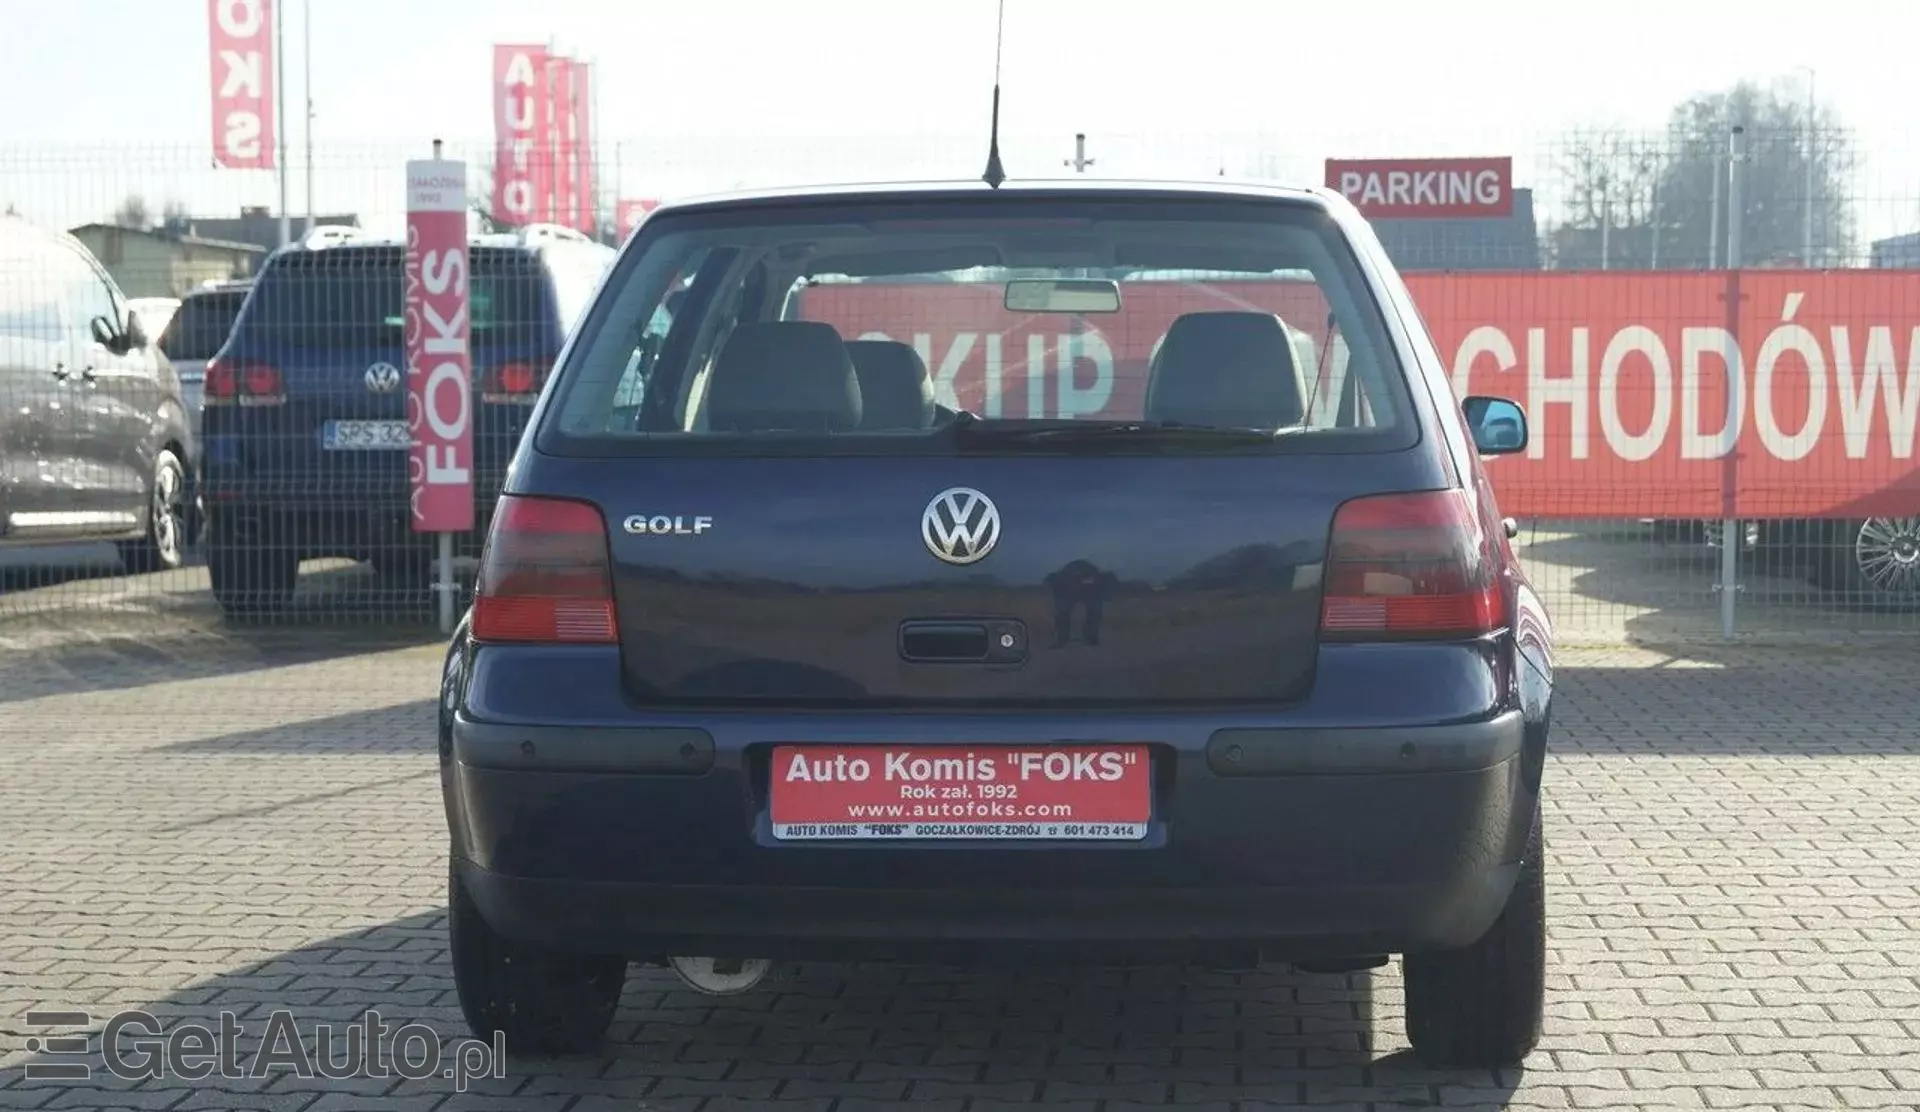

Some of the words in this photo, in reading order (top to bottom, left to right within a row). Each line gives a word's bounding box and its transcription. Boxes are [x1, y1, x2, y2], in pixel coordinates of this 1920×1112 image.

[503, 53, 535, 215] AUTO
[1340, 169, 1501, 206] PARKING
[421, 248, 469, 484] FOKS
[857, 331, 1114, 420] KUP
[623, 515, 713, 534] GOLF
[786, 753, 870, 782] Auto
[885, 752, 997, 782] Komis
[1008, 752, 1137, 781] "FOKS"
[900, 785, 936, 799] Rok
[941, 784, 973, 799] zał.
[978, 784, 1018, 799] 1992
[848, 801, 1072, 817] www.autofoks.com
[786, 825, 816, 836] AUTO
[820, 825, 858, 836] KOMIS
[915, 822, 1041, 836] GOCZAŁKOWICE-ZDRÓJ
[1064, 825, 1085, 836] 601
[1088, 825, 1110, 836] 473
[1113, 825, 1134, 836] 414
